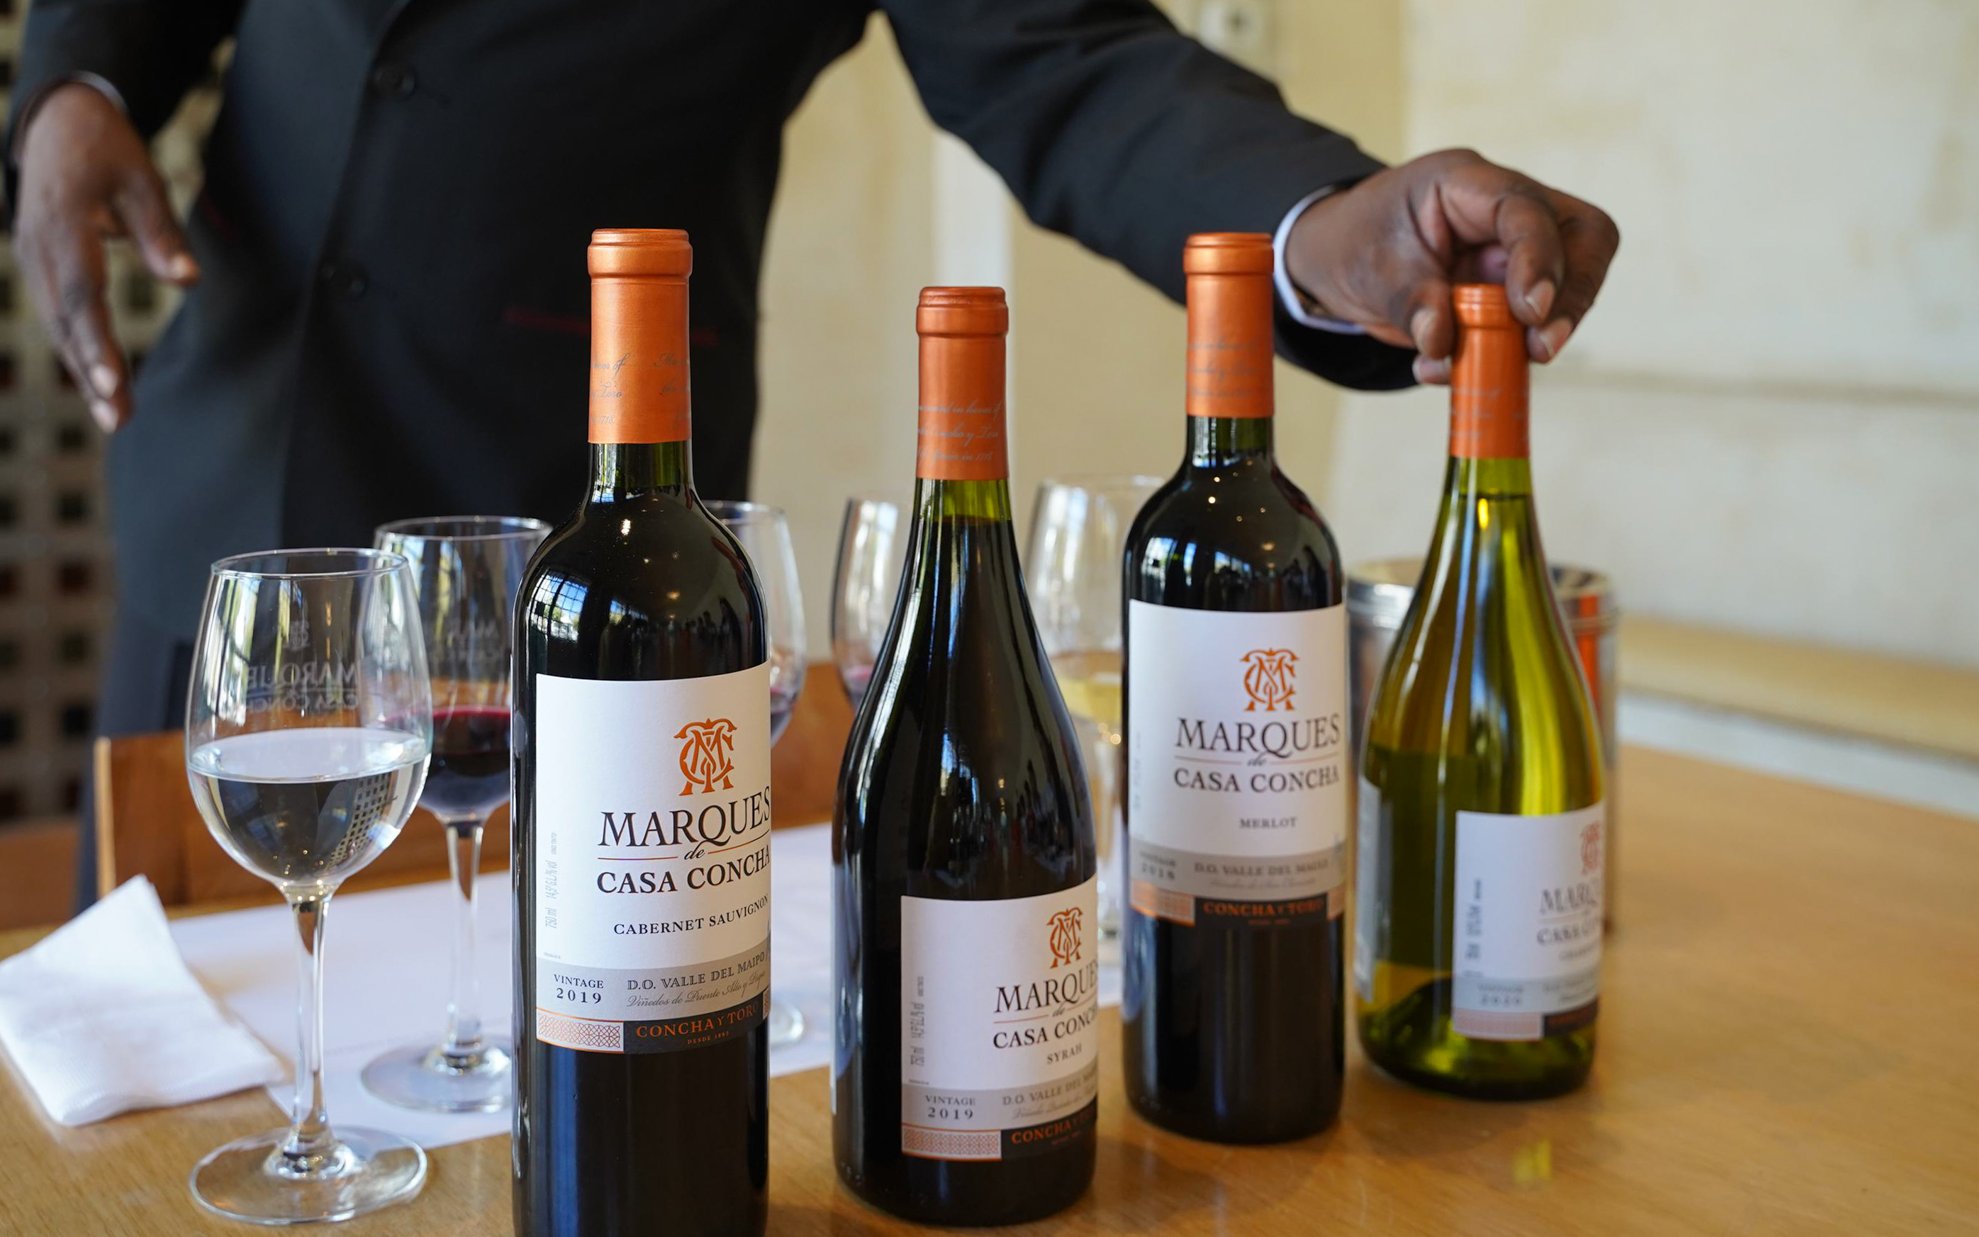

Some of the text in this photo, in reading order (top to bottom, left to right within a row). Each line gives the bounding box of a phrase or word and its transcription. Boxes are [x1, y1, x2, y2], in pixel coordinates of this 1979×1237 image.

[1175, 713, 1340, 759] MARQUES
[1174, 764, 1340, 794] CASA CONCHA
[597, 785, 771, 847] MARQUES
[1239, 817, 1298, 829] MERLOT
[683, 837, 706, 861] de
[596, 871, 678, 895] CASA
[686, 844, 770, 891] CONCHA
[1223, 865, 1263, 877] VALLE
[613, 895, 769, 936] CABERNET SAUVIGNON
[1202, 902, 1275, 916] CONCHA
[553, 974, 604, 990] VINTAGE
[627, 951, 765, 991] D.O. VALLE DEL MAIPO
[555, 987, 602, 1004] 2019
[993, 958, 1098, 1014] MARQUE
[635, 1017, 714, 1039] CONCHA
[717, 1015, 724, 1027] Y
[992, 1026, 1048, 1049] CASA
[1046, 1043, 1083, 1064] SYRAH
[925, 1094, 976, 1106] VINTAGE
[1029, 1086, 1062, 1101] VALLE
[927, 1106, 974, 1120] 2019
[1011, 1120, 1072, 1144] CONCHA
